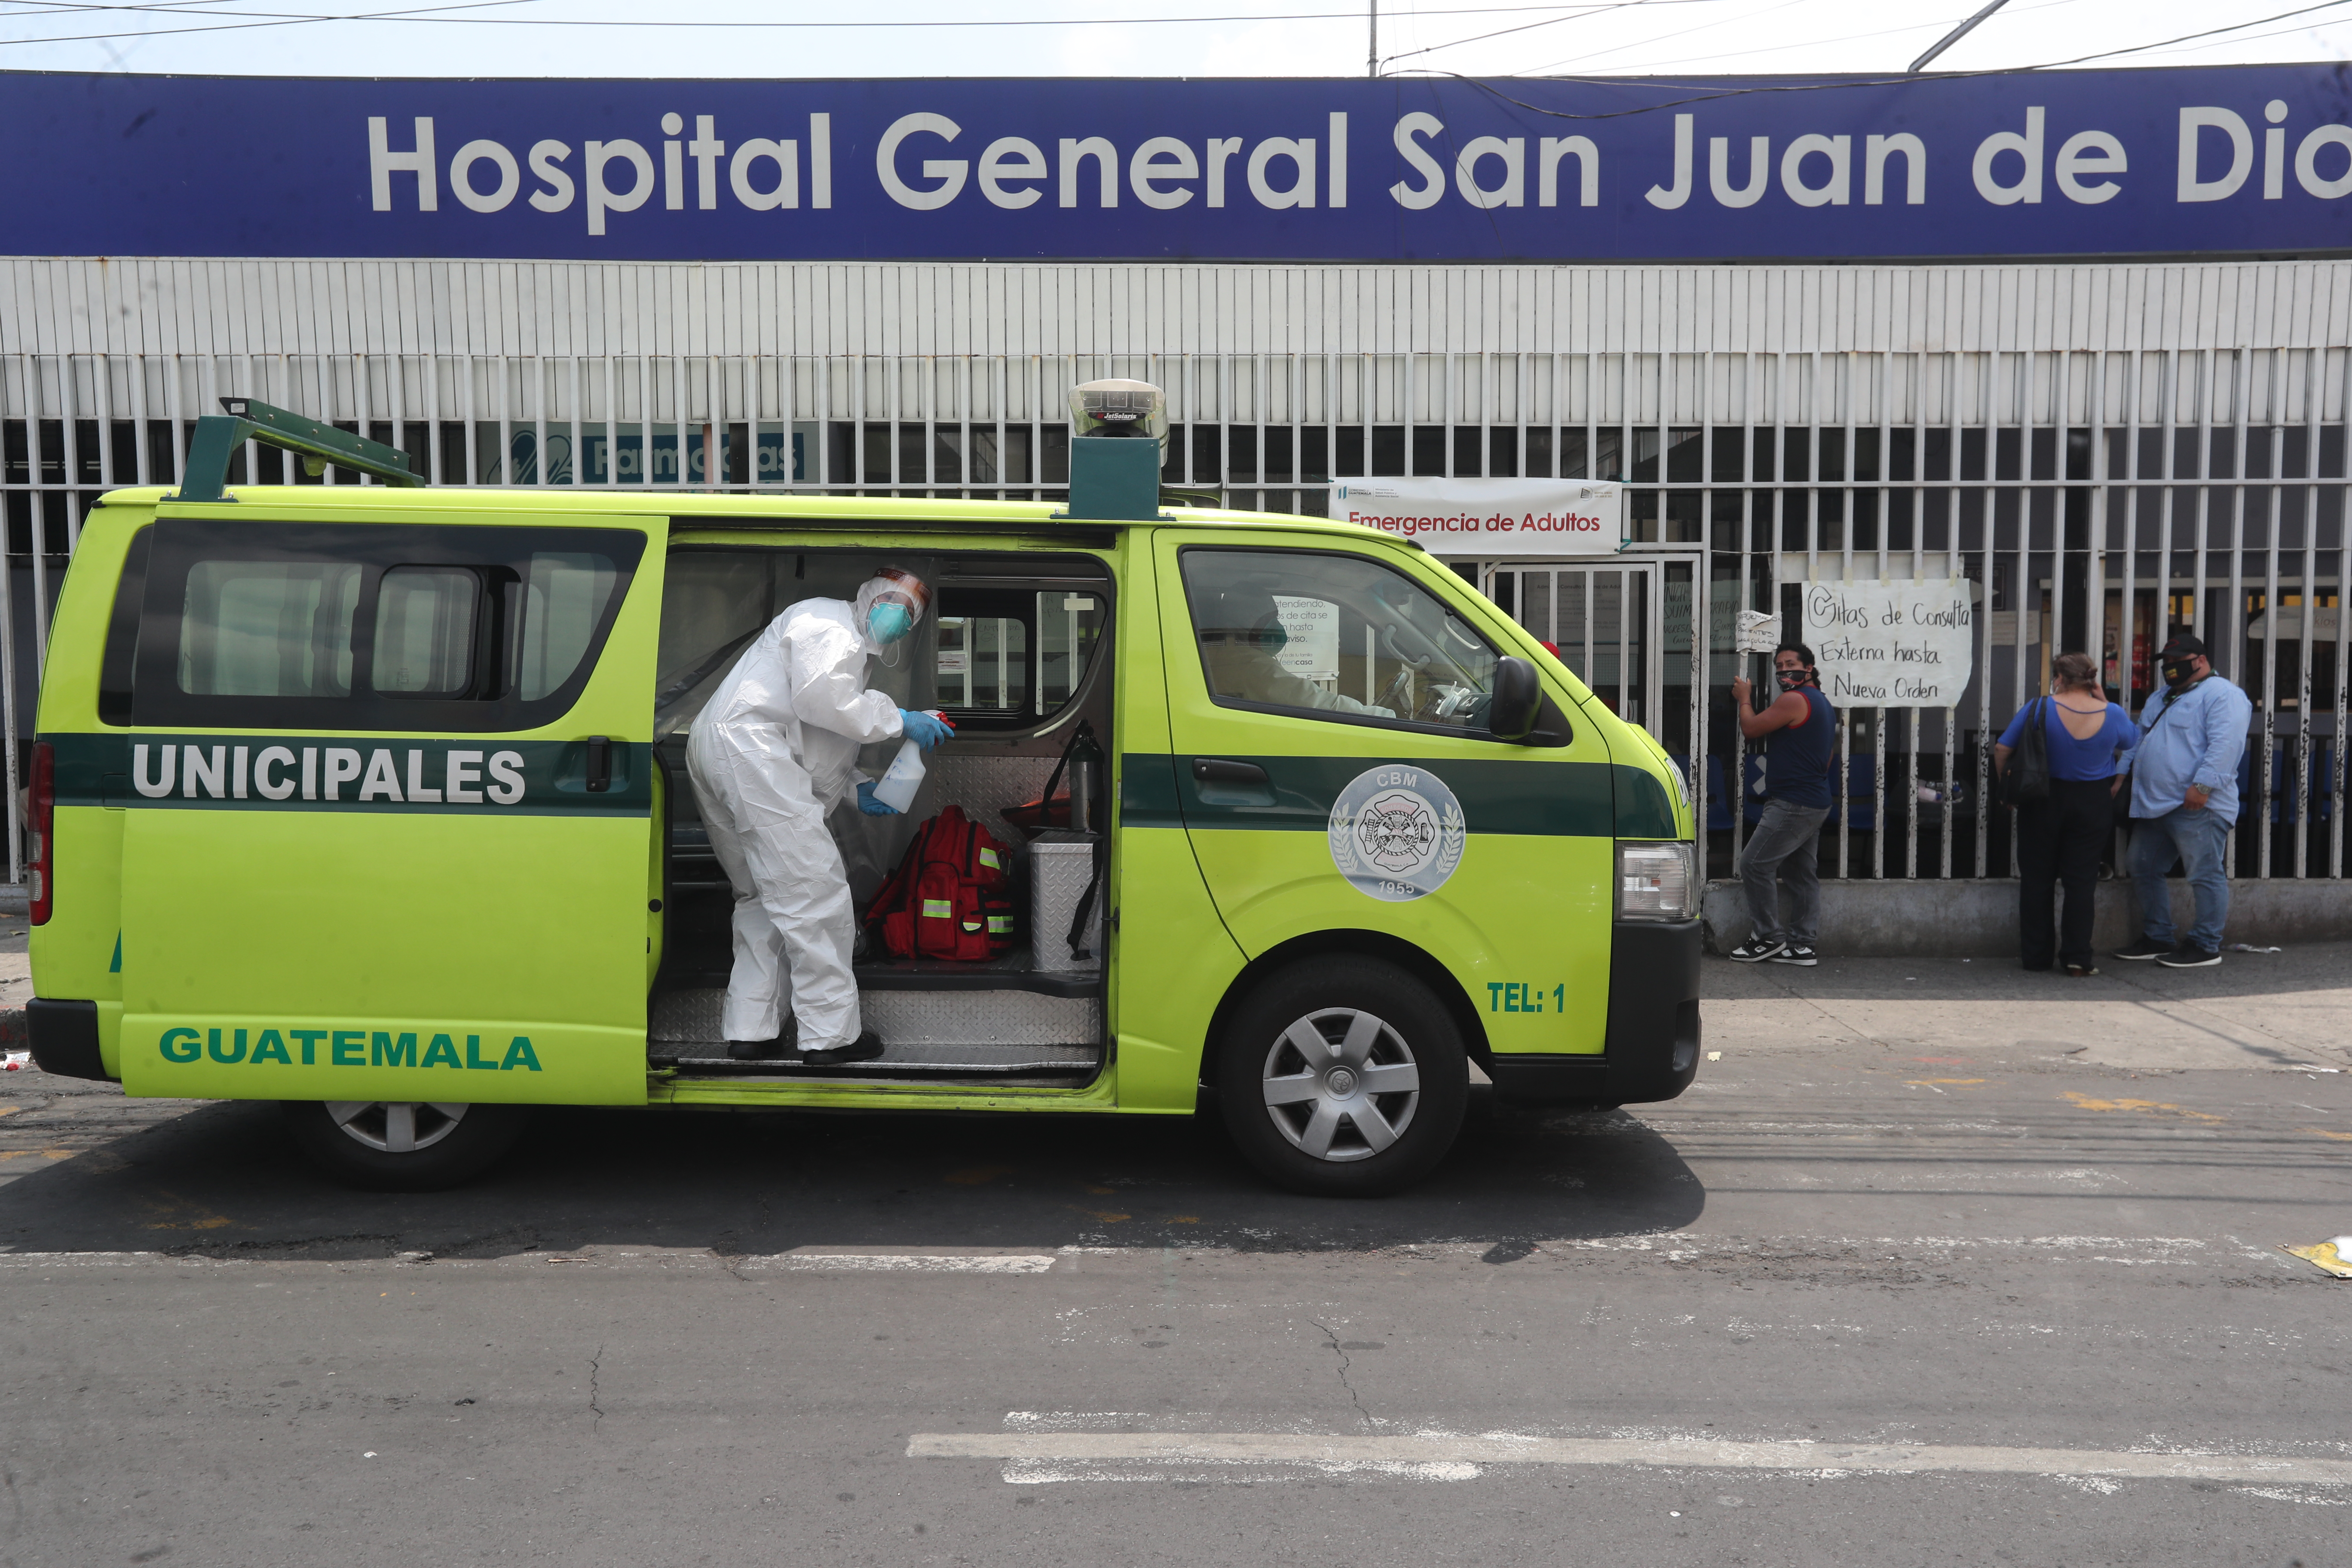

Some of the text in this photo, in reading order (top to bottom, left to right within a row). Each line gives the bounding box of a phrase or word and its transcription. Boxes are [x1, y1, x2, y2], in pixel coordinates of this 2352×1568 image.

[367, 111, 832, 237] Hospital
[876, 111, 1348, 211] General
[1389, 111, 1599, 211] San
[1645, 113, 1926, 210] Juan
[1972, 106, 2128, 205] de
[1349, 512, 1600, 536] Emergencia de Adultos
[1808, 585, 1868, 628] Citas
[1882, 600, 1903, 626] de
[1913, 600, 1969, 629] Consulta
[1819, 640, 1942, 664] Externa hasta
[1834, 672, 1938, 699] Nueva Orden
[1376, 772, 1418, 787] CBM
[1381, 804, 1412, 813] BOMBEROS
[1378, 880, 1415, 894] 1955
[1487, 982, 1565, 1013] TEL: 1
[159, 1026, 543, 1072] GUATEMALA
